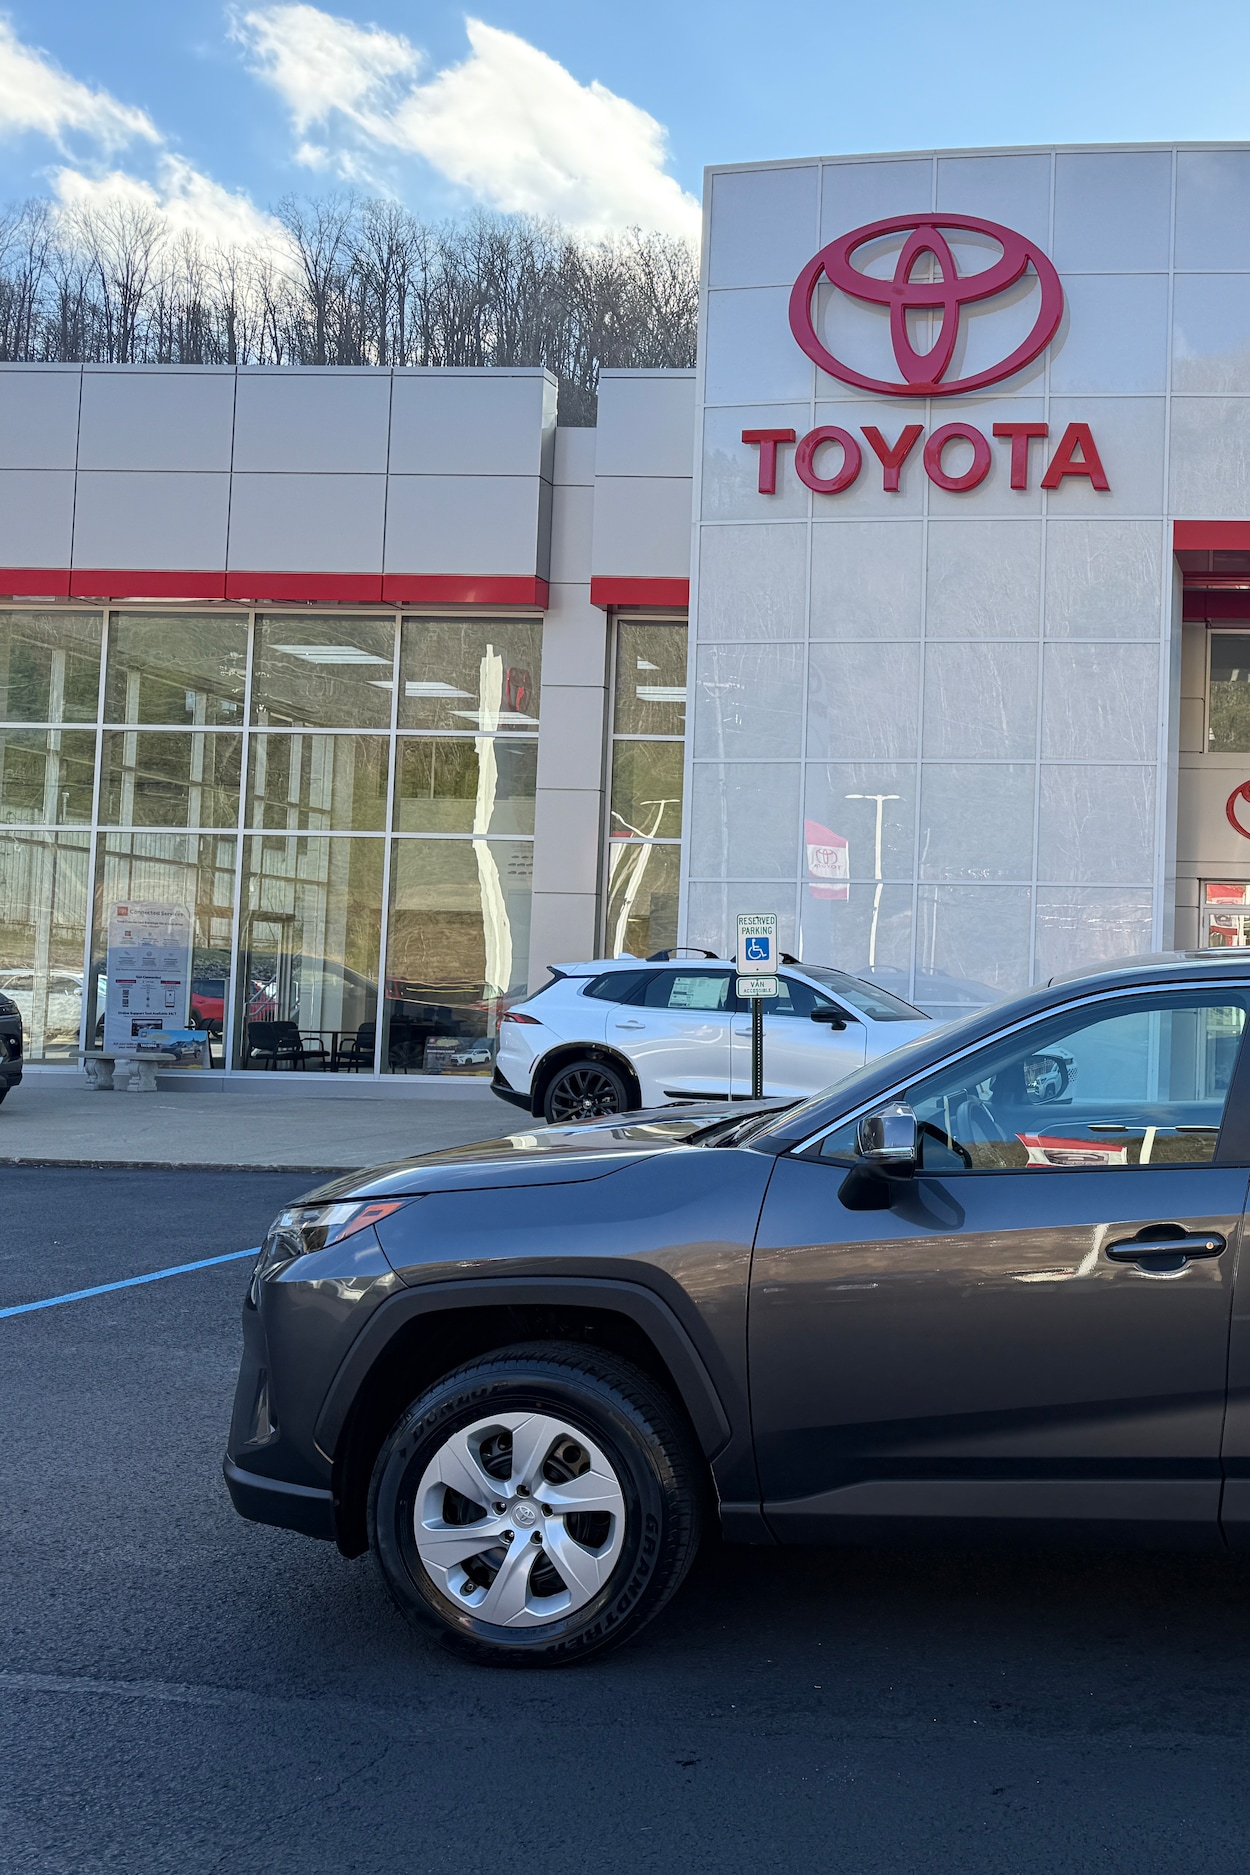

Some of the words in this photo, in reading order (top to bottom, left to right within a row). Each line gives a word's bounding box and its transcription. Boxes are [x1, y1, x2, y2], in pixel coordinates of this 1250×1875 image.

[741, 422, 1111, 495] TOYOTA
[738, 916, 775, 926] RESERVED
[741, 926, 773, 935] PARKING
